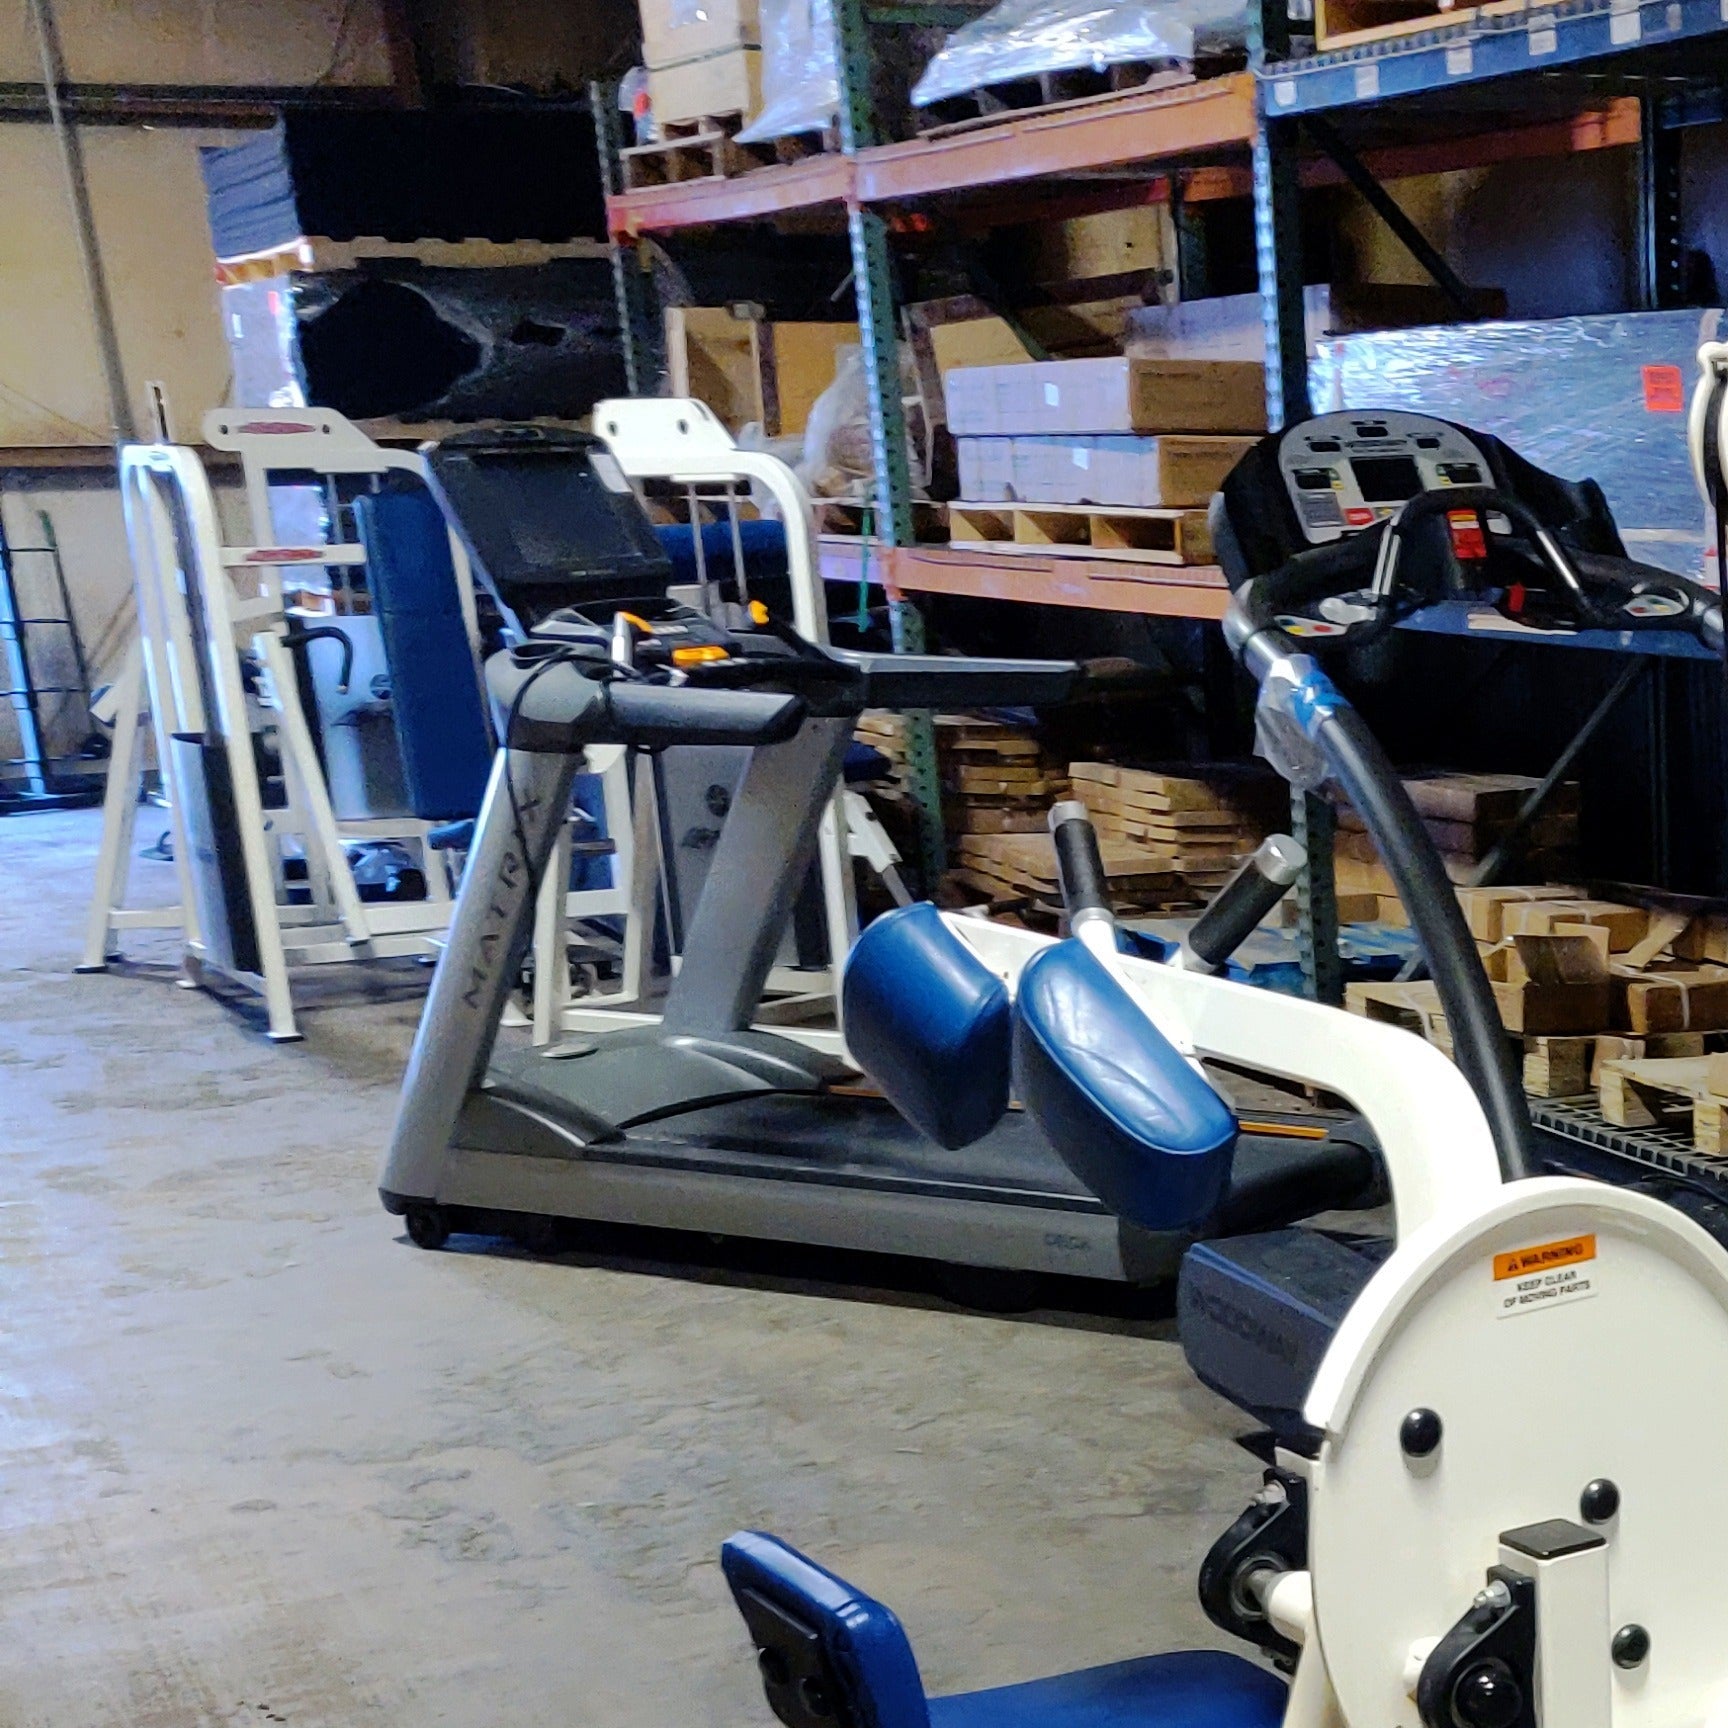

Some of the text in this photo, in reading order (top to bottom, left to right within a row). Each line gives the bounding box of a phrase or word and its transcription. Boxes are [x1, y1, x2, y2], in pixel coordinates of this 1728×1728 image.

[1521, 1243, 1584, 1267] WARNING
[1517, 1270, 1577, 1291] KEEP CLEAR
[1503, 1279, 1590, 1309] OF MOVING PARTS
